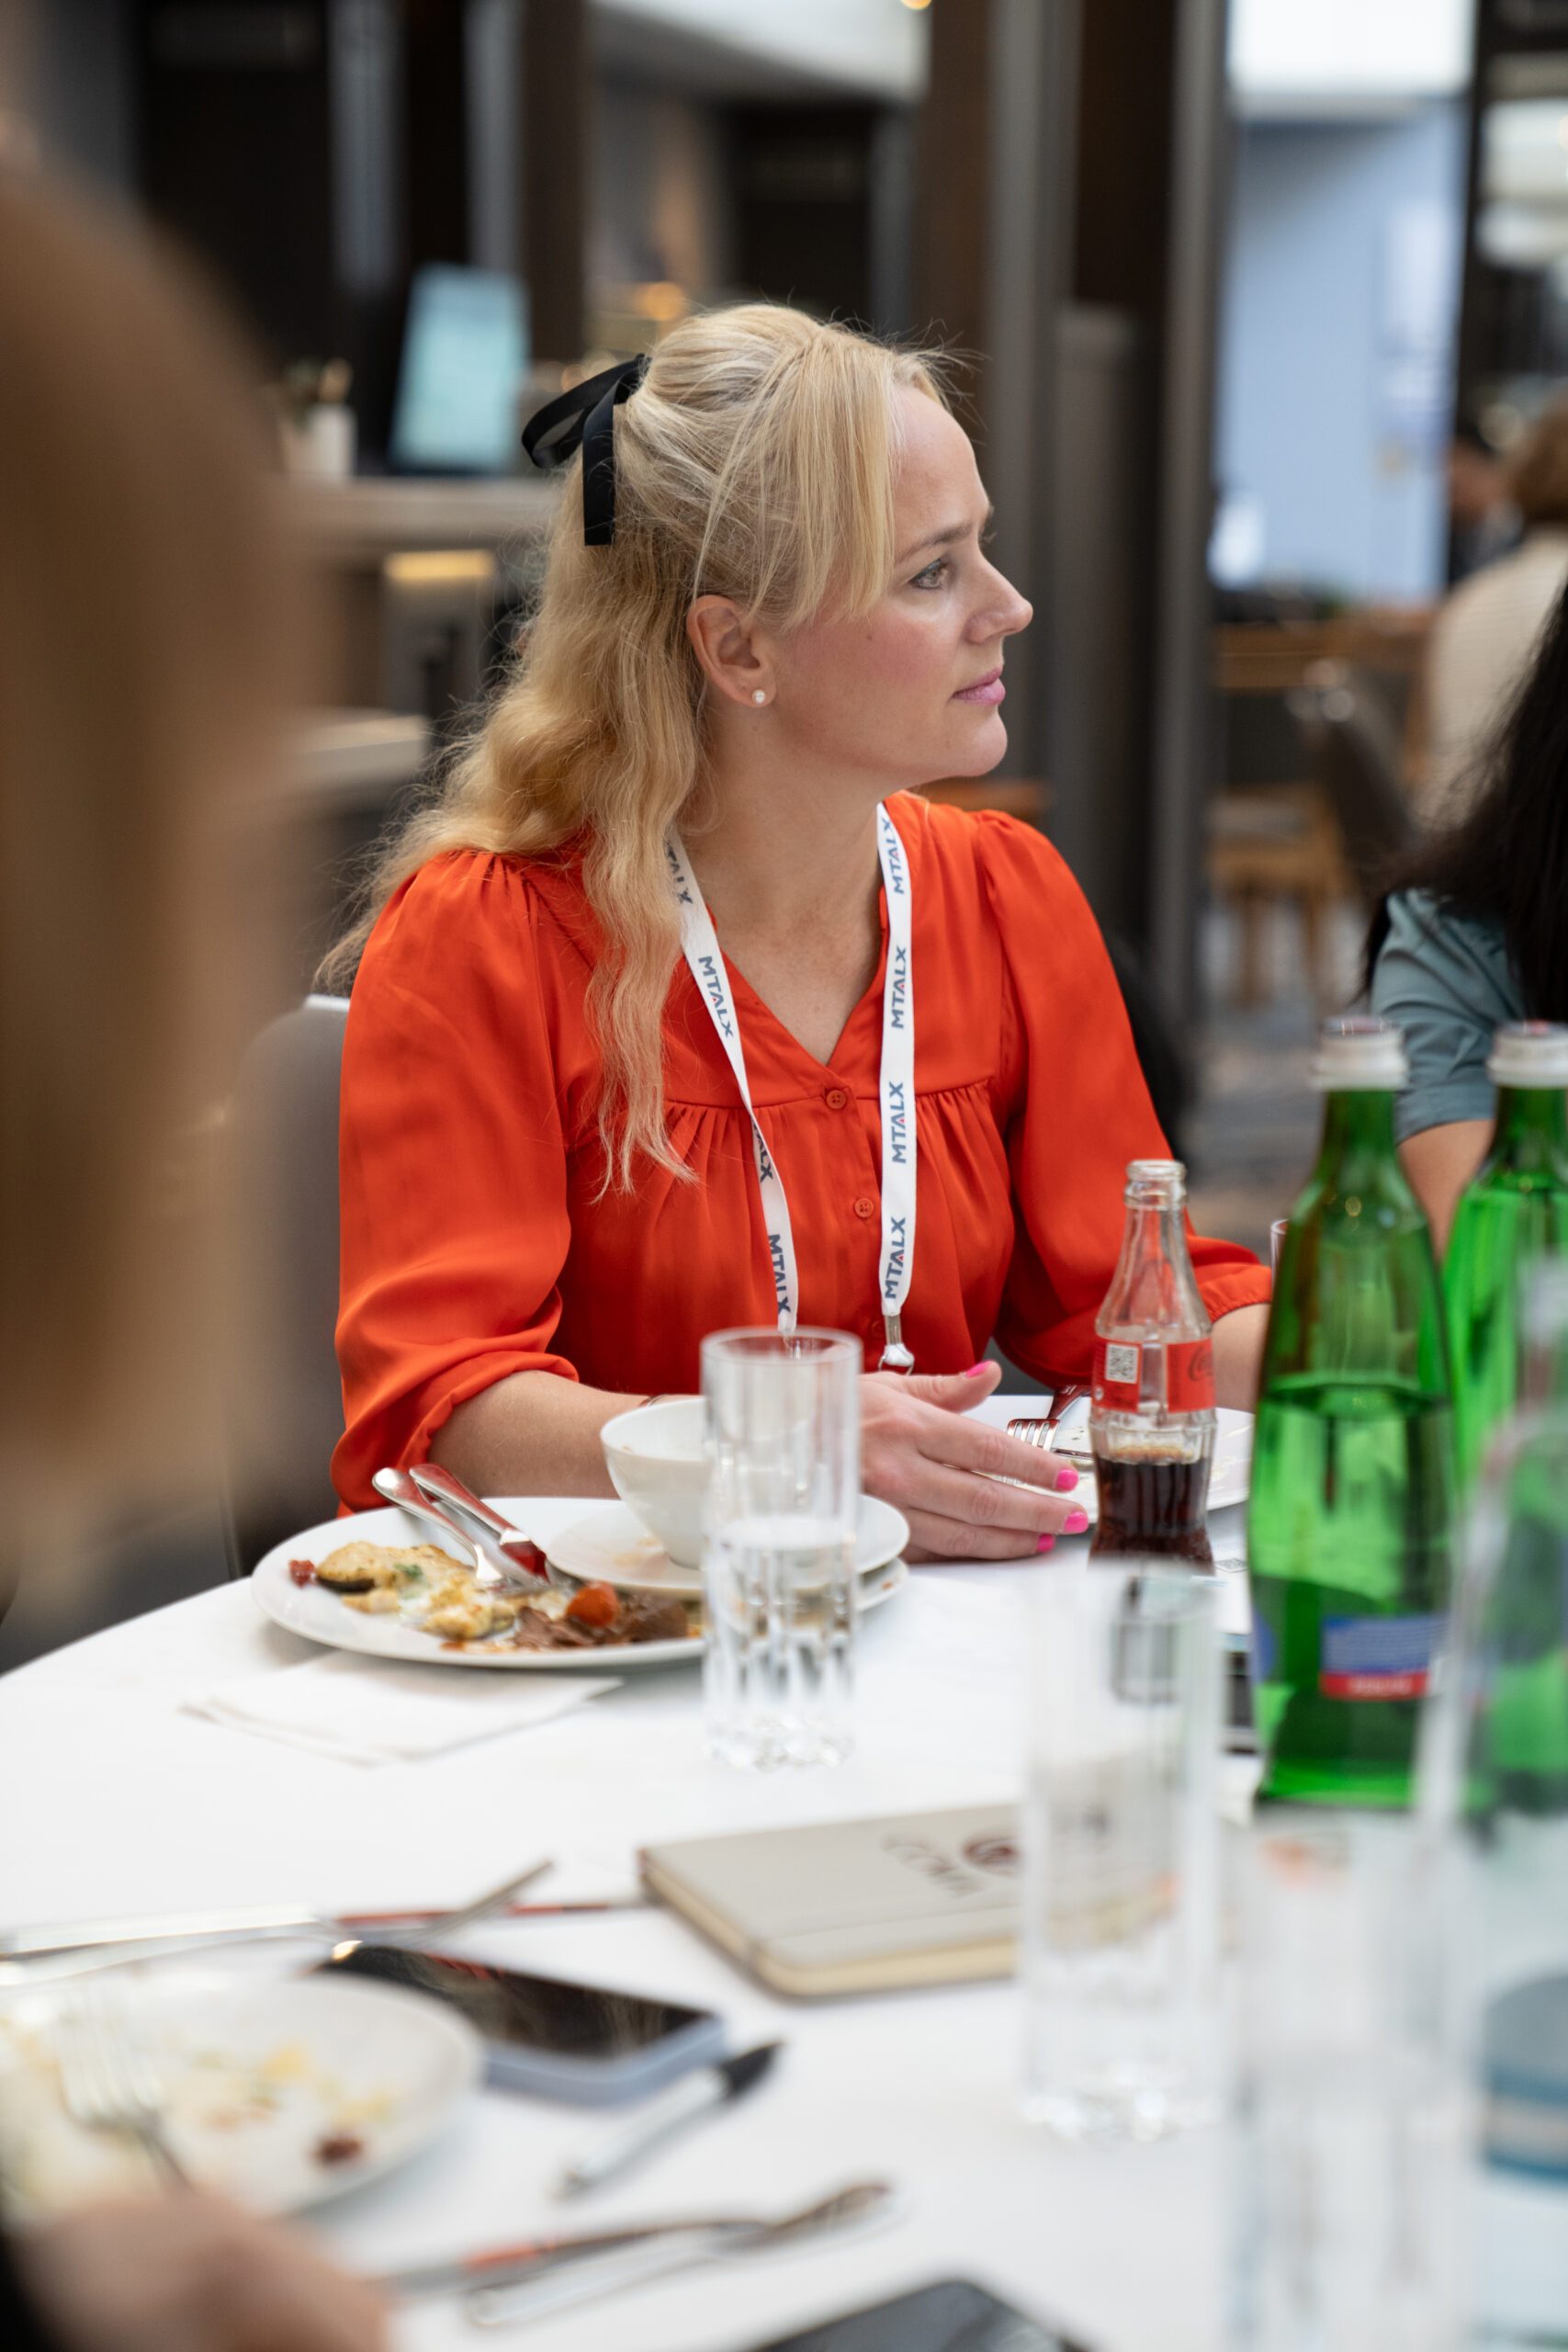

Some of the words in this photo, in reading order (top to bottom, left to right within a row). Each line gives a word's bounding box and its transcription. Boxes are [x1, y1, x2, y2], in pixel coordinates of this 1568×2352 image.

[881, 817, 905, 895] MTALX
[698, 956, 734, 1037] MTALX
[891, 945, 907, 1030] MTALX
[888, 1080, 907, 1164] MTALX
[885, 1216, 907, 1299] MTALX
